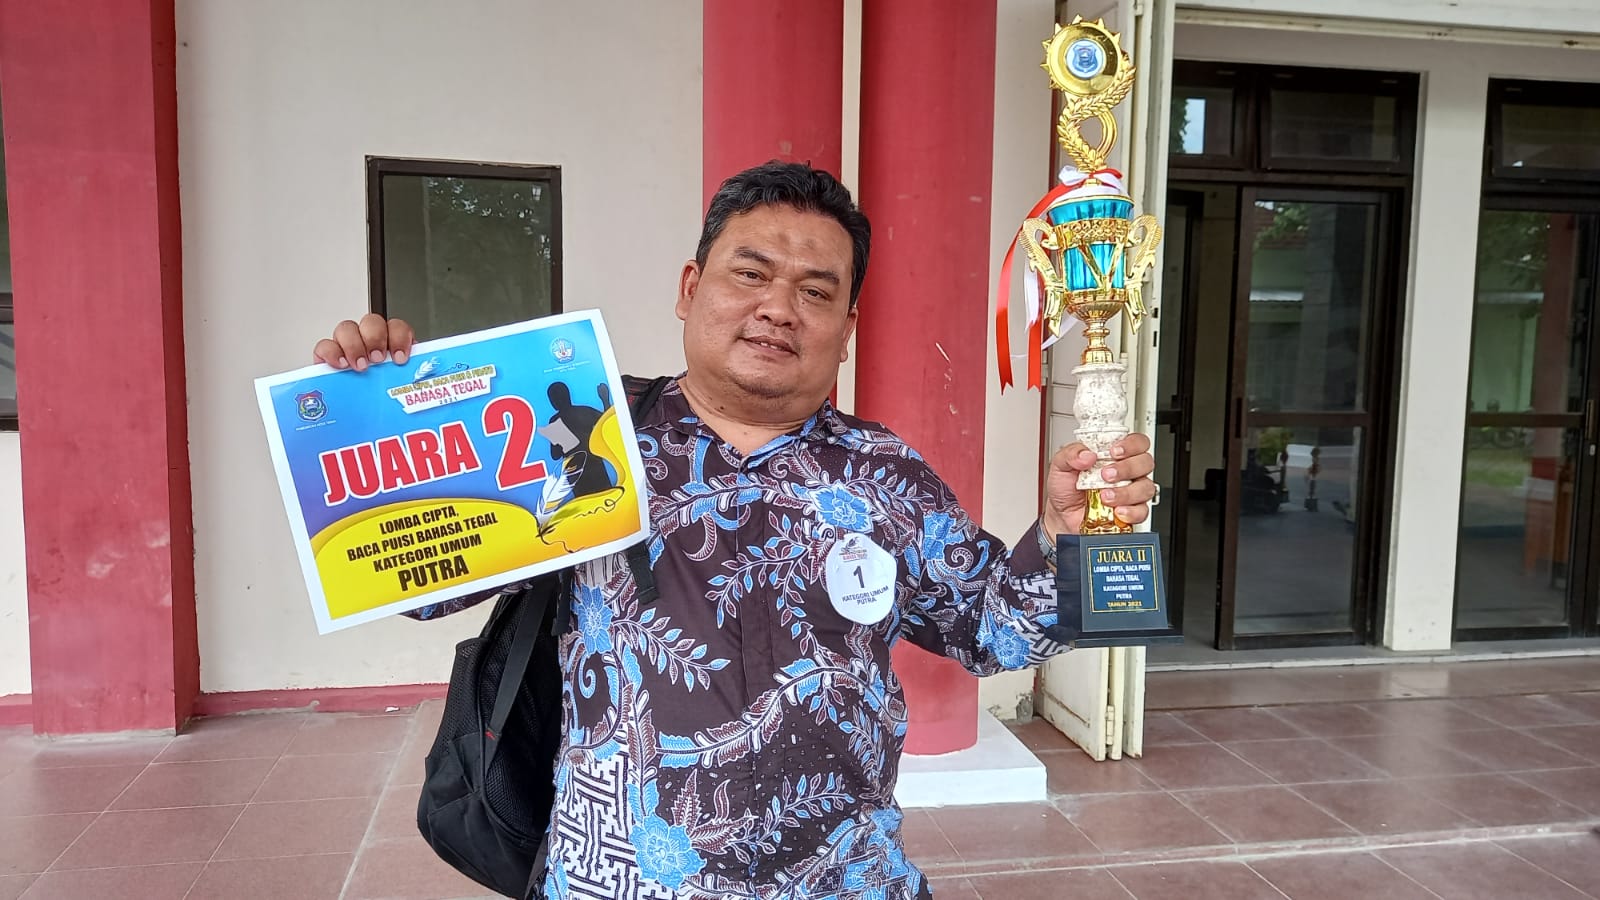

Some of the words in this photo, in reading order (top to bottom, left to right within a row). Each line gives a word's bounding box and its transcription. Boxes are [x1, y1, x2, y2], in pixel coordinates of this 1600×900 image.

[390, 385, 414, 397] LOMBA
[405, 387, 451, 406] BAHASA
[451, 378, 487, 396] TEGAL
[320, 422, 481, 505] JUARA
[484, 397, 547, 489] 2
[379, 514, 421, 535] LOMBA
[422, 505, 459, 524] CIPTA,
[347, 542, 381, 561] BACA
[382, 534, 415, 552] PUISI
[416, 521, 463, 543] BAHASA
[463, 512, 498, 531] TEGAL
[373, 545, 438, 572] KATEGORI
[439, 533, 482, 555] UMUM
[1097, 549, 1133, 563] JUARA
[1137, 549, 1146, 562] II
[398, 554, 470, 592] PUTRA
[853, 565, 865, 589] 1
[1093, 565, 1109, 573] LOMBA
[1110, 565, 1125, 573] CIPTA,
[842, 592, 870, 602] KATEGORI
[870, 585, 889, 597] UMUM
[856, 596, 877, 605] PUTRA
